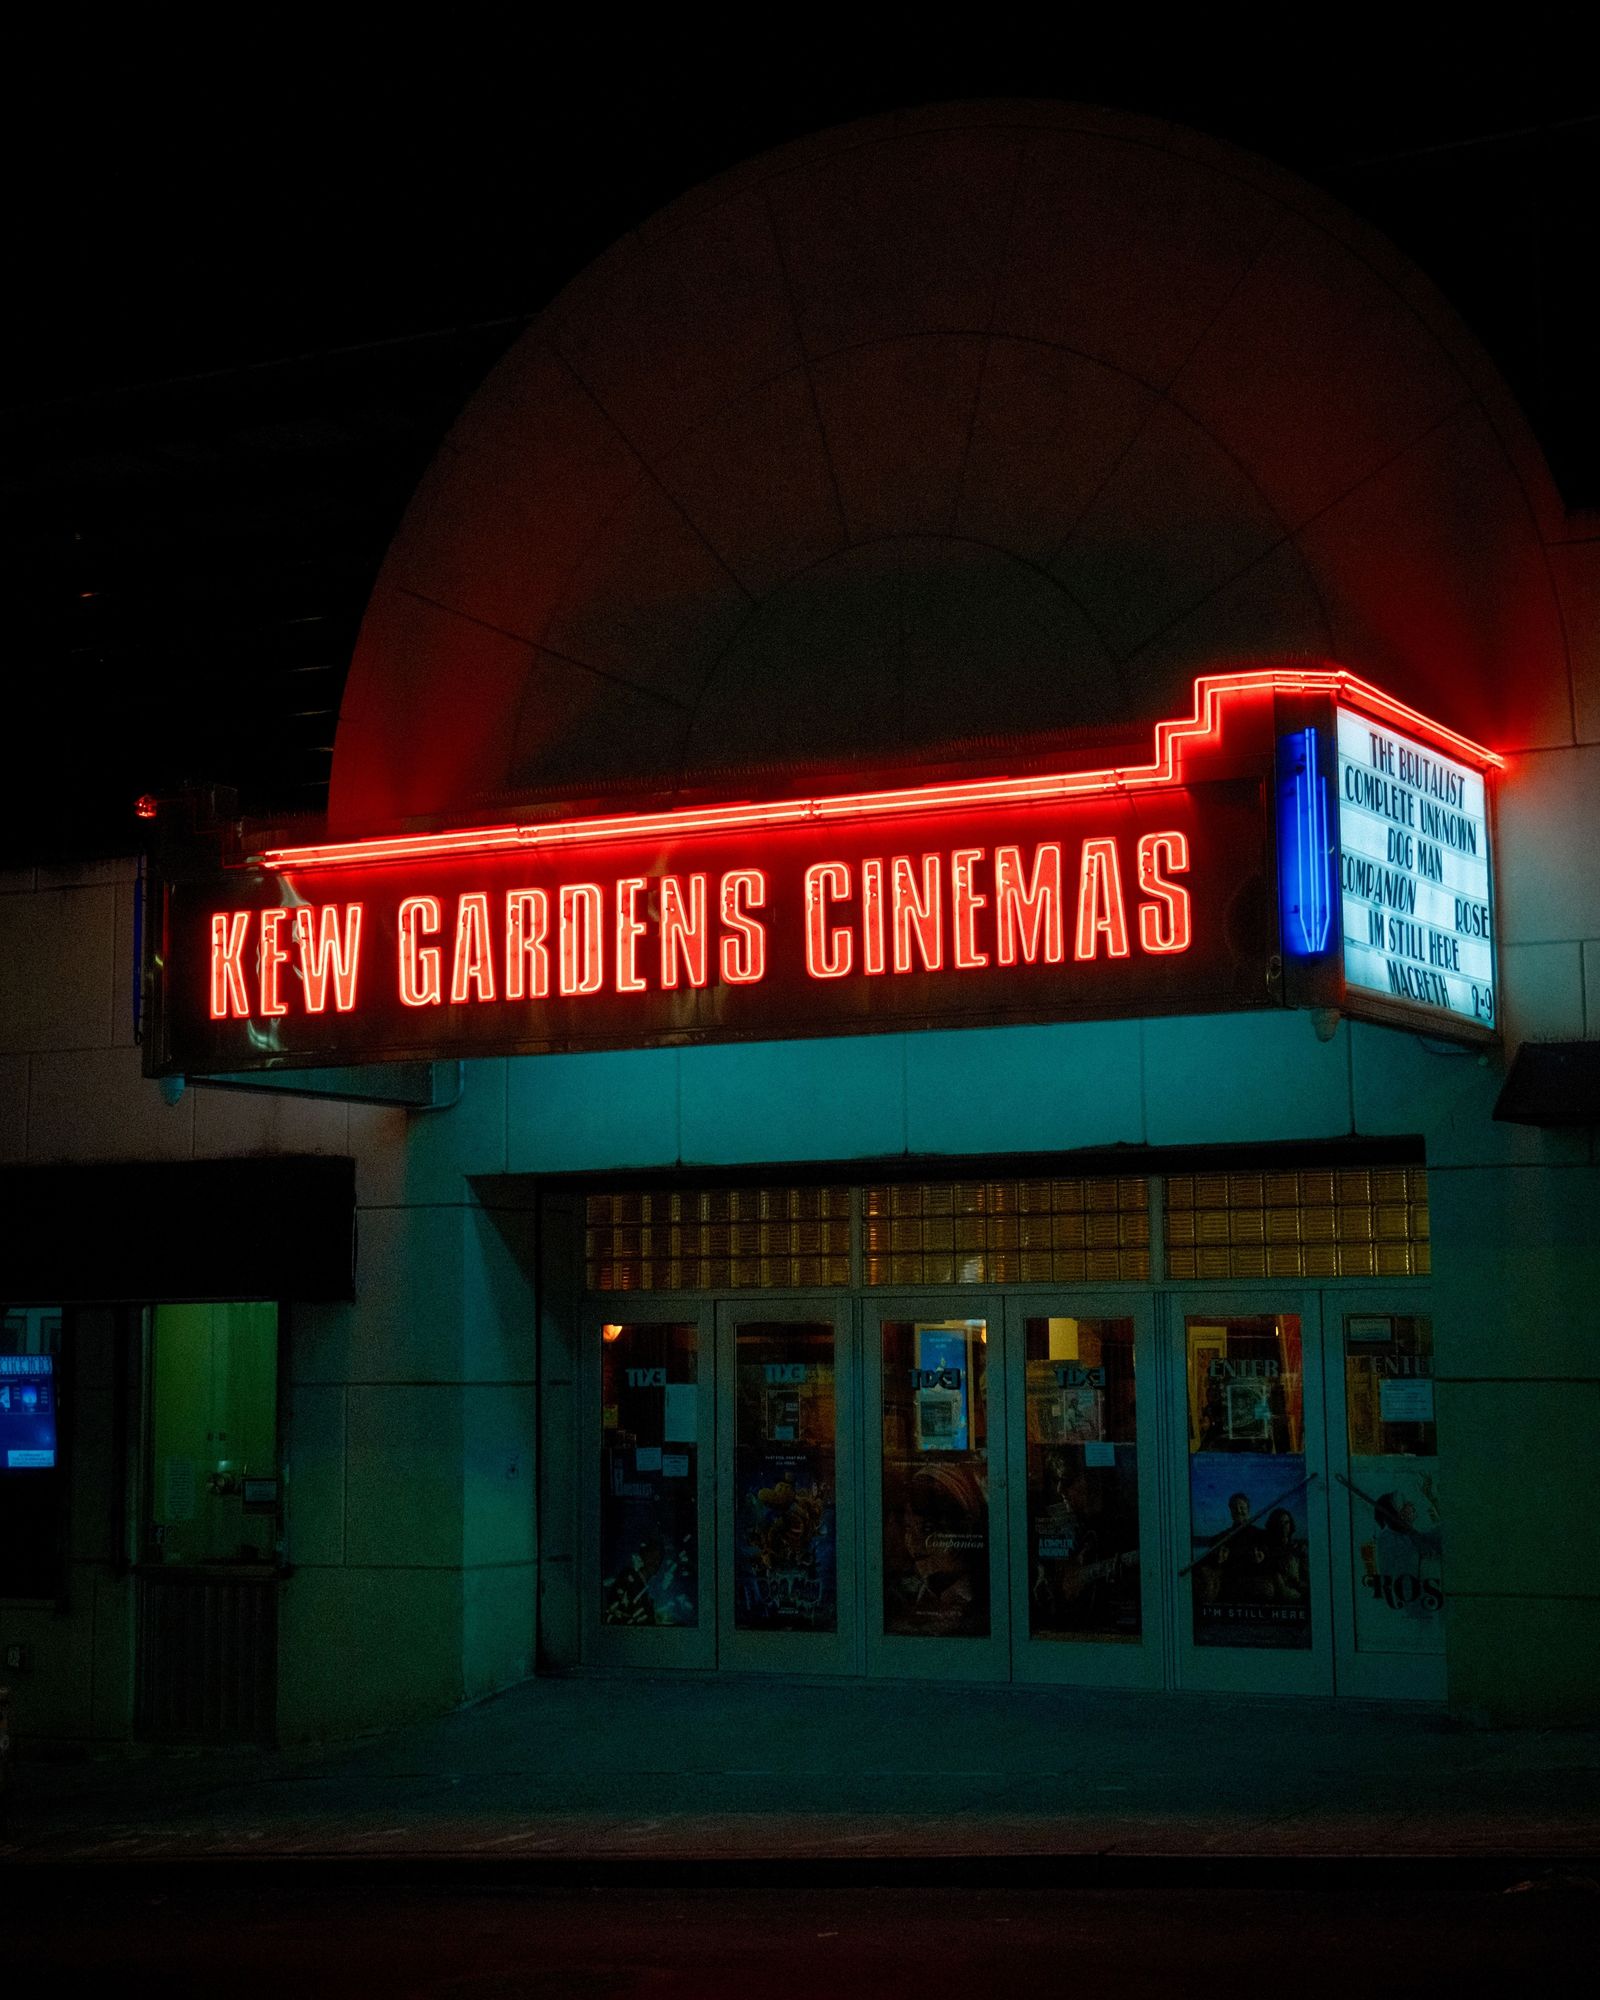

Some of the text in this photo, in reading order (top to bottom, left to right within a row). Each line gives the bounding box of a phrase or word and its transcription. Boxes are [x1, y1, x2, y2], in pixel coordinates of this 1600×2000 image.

[1369, 732, 1465, 808] THE BRUTALIST
[1345, 765, 1477, 855] COMPLETE UNKNOWN
[1387, 827, 1443, 883] DOG MAN
[210, 831, 1192, 1020] KEW GARDENS CINEMAS
[1341, 853, 1490, 939] COMPANION ROSE
[1368, 910, 1460, 972] IM STILL HERE
[1387, 959, 1448, 1008] MACBETH
[1209, 1358, 1280, 1378] ENTER
[1202, 1607, 1306, 1620] I'M STILL HERE
